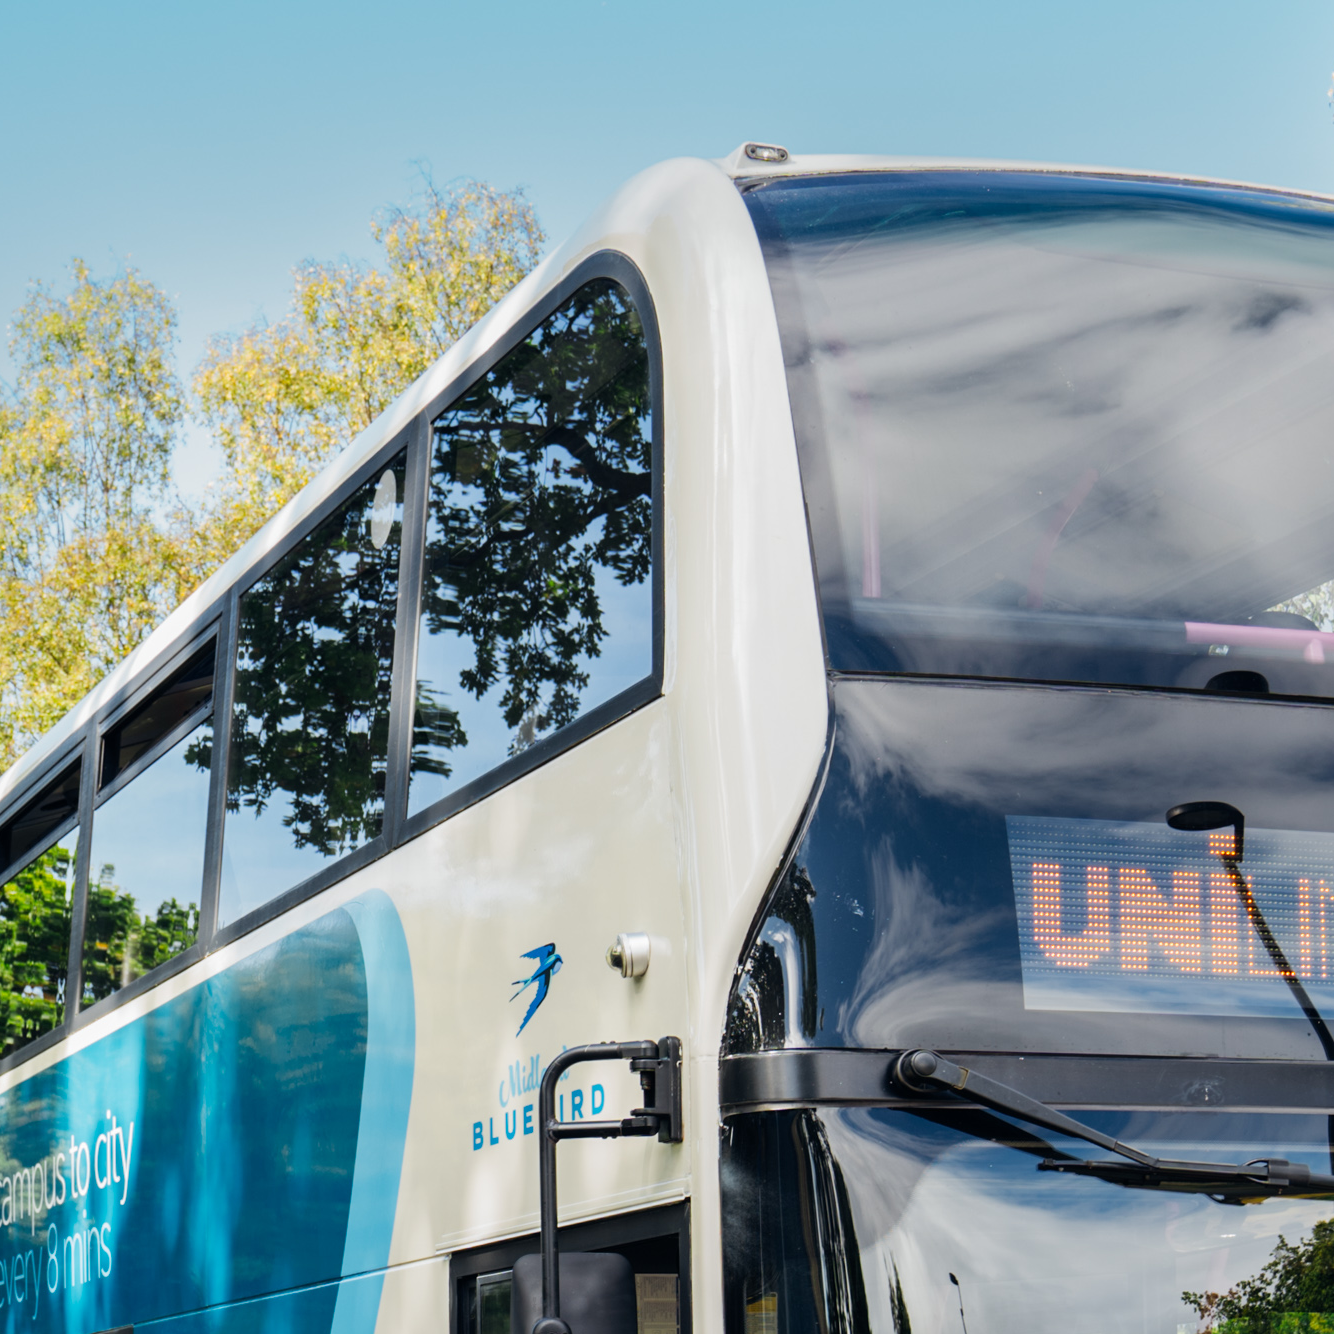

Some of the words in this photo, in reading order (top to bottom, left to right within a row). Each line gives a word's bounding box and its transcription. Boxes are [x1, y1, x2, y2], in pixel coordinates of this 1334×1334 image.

[70, 1134, 91, 1199] to
[94, 1109, 135, 1206] city
[472, 1083, 605, 1151] BLUEIRD
[47, 1222, 59, 1294] 8
[63, 1209, 113, 1290] mins
